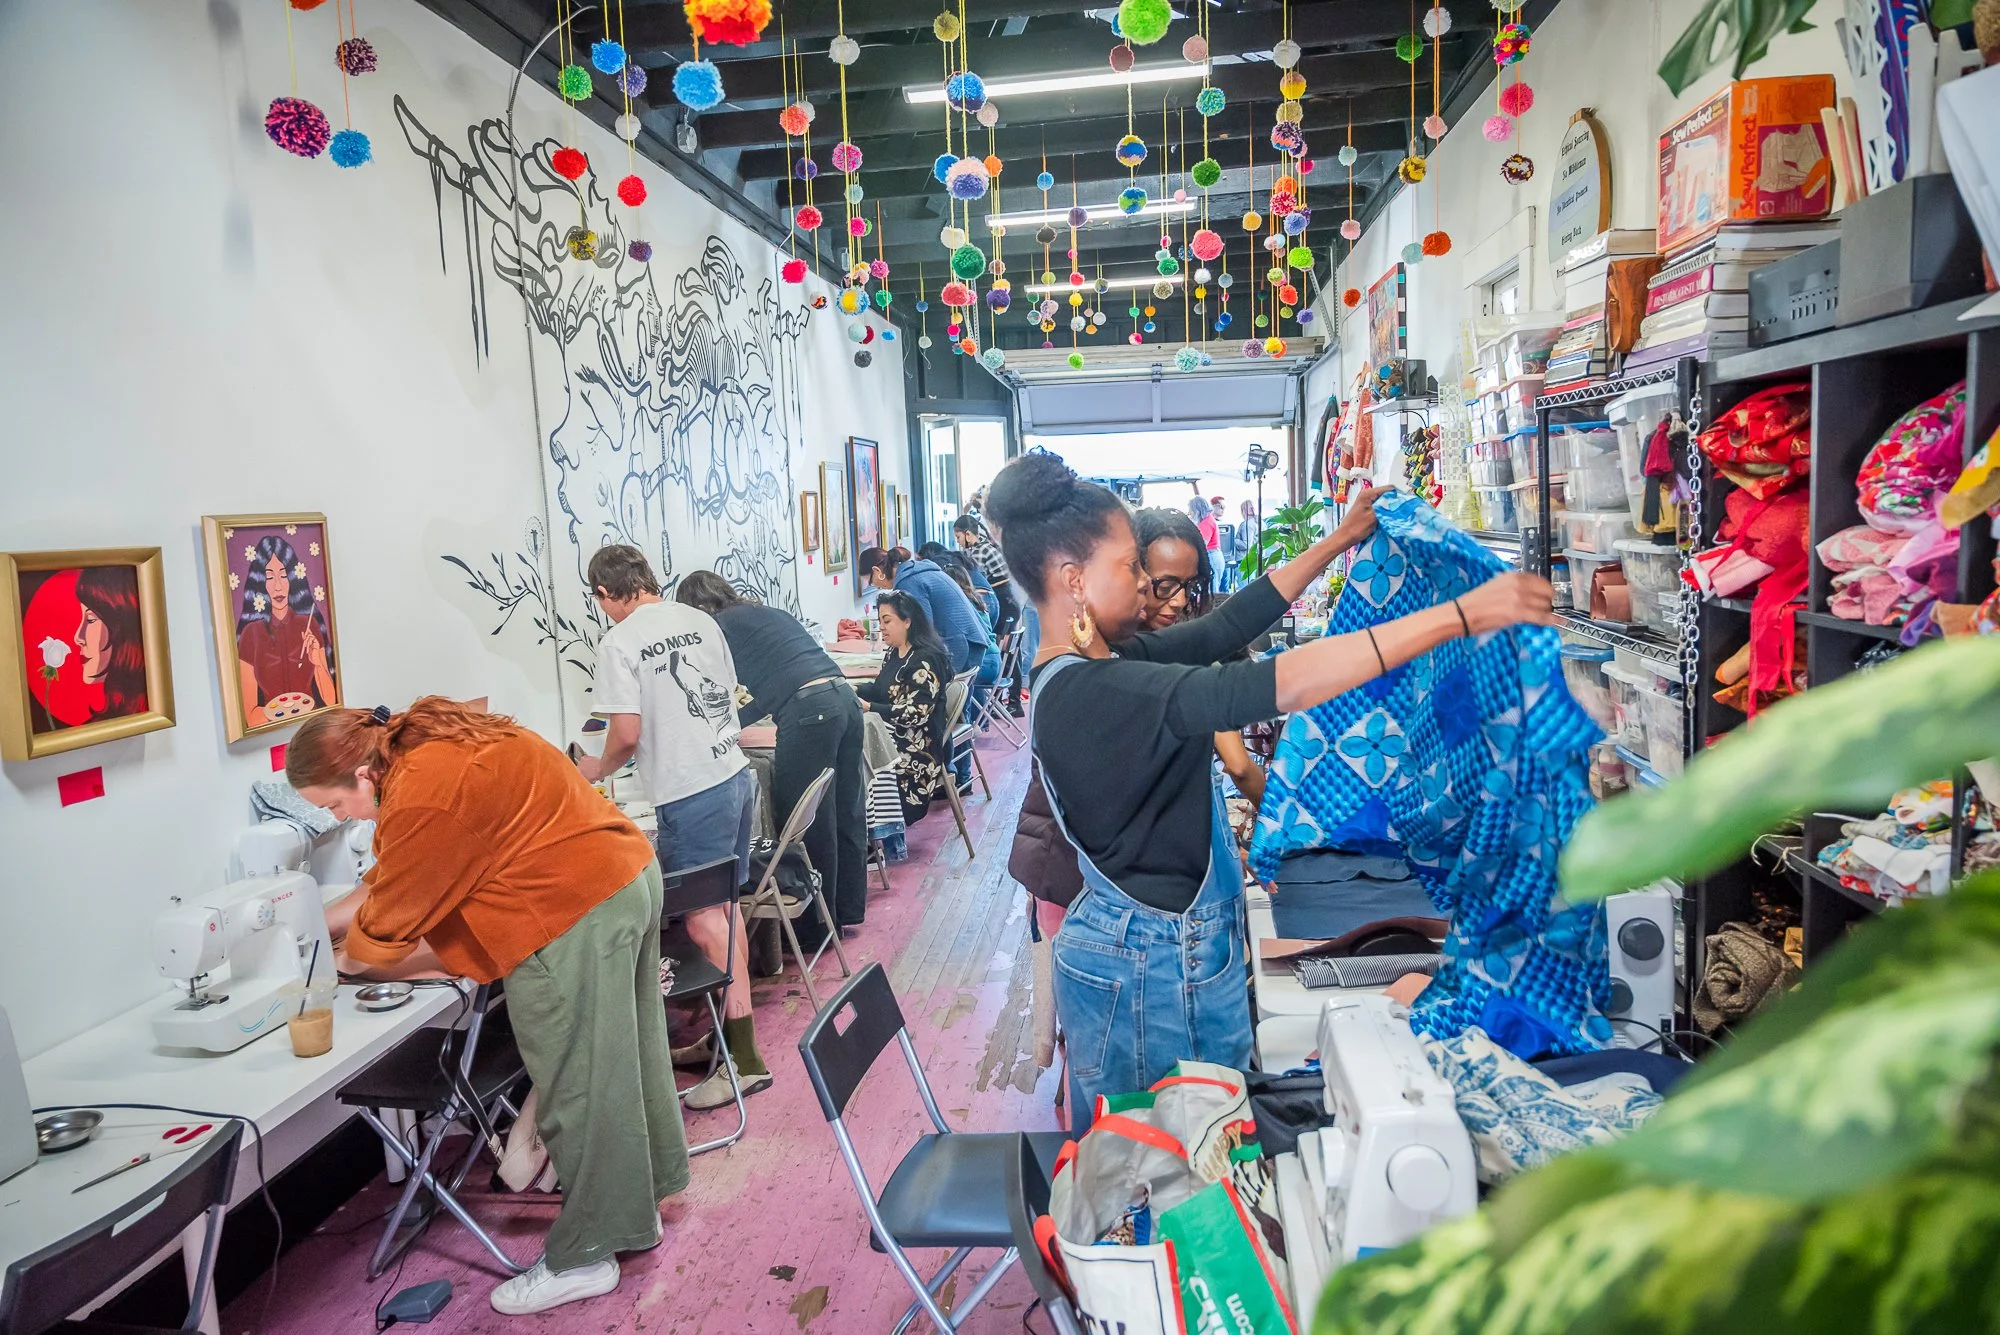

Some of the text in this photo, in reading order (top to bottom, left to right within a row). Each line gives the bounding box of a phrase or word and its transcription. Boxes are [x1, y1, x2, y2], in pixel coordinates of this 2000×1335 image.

[1672, 125, 1687, 146] Sew
[1686, 105, 1713, 137] Perfect
[1739, 115, 1757, 176] Perfect
[1741, 177, 1757, 210] Sew
[640, 631, 703, 661] NO MODS
[655, 663, 667, 676] THE
[271, 891, 293, 904] SINGER
[1203, 1121, 1243, 1182] HAPPY
